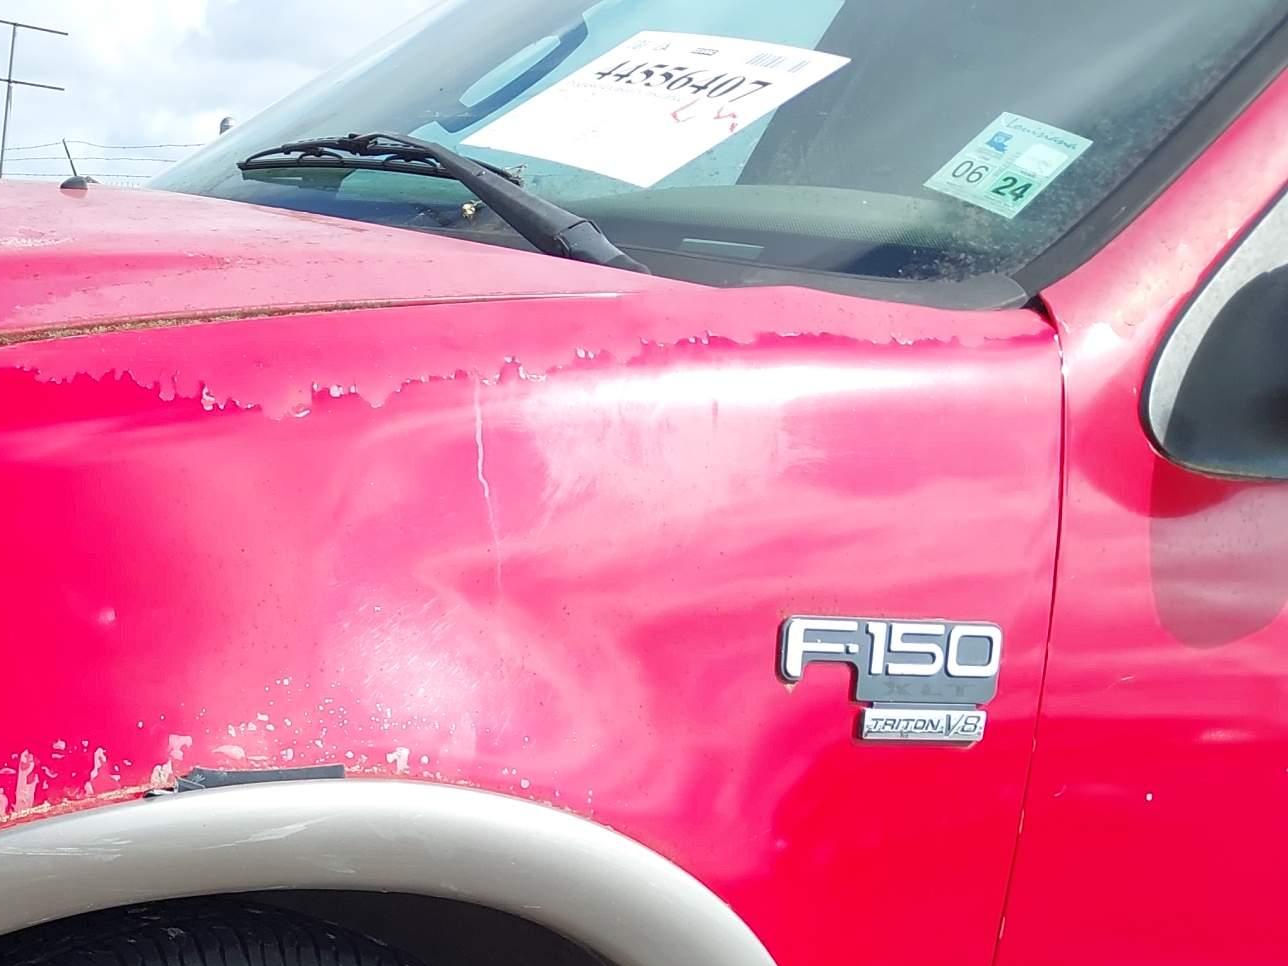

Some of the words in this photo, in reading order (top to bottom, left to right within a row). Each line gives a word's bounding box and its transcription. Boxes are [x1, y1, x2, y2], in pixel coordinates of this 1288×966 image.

[594, 60, 773, 103] 44556407
[951, 160, 989, 184] 06
[991, 176, 1033, 202] 24
[870, 717, 941, 732] TRITON
[944, 714, 982, 737] V8
